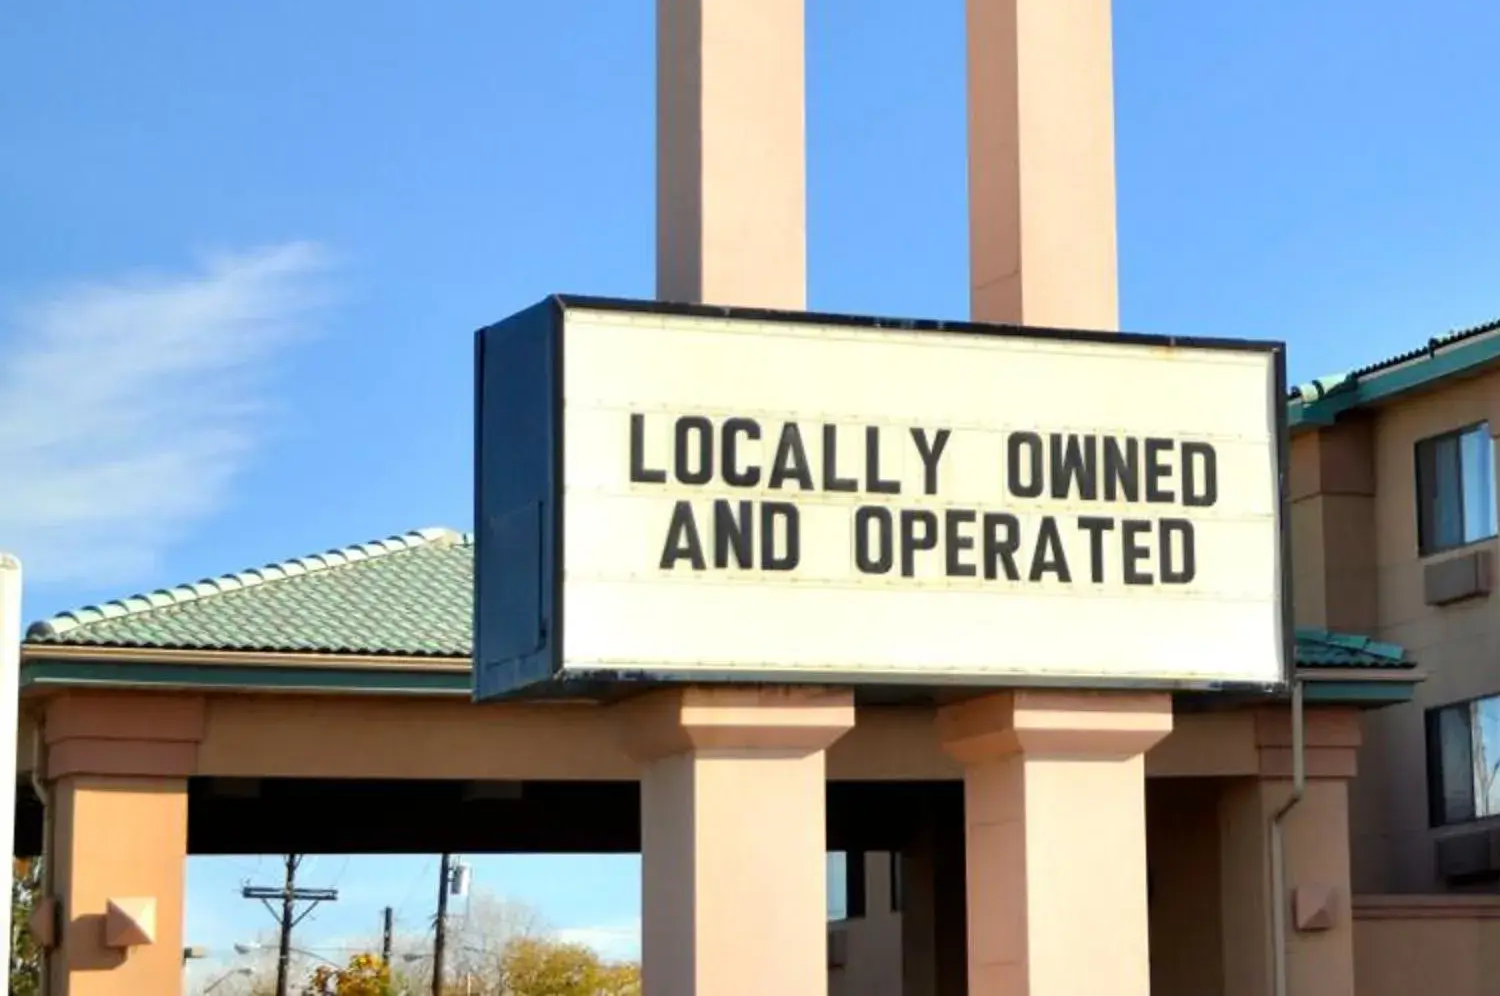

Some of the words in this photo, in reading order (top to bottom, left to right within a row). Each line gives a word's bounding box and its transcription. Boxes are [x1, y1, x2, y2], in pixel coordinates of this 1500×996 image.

[629, 412, 952, 496] LOCALLY
[1006, 431, 1218, 508] OWNED
[658, 499, 801, 572] AND
[855, 504, 1197, 585] OPERATED
